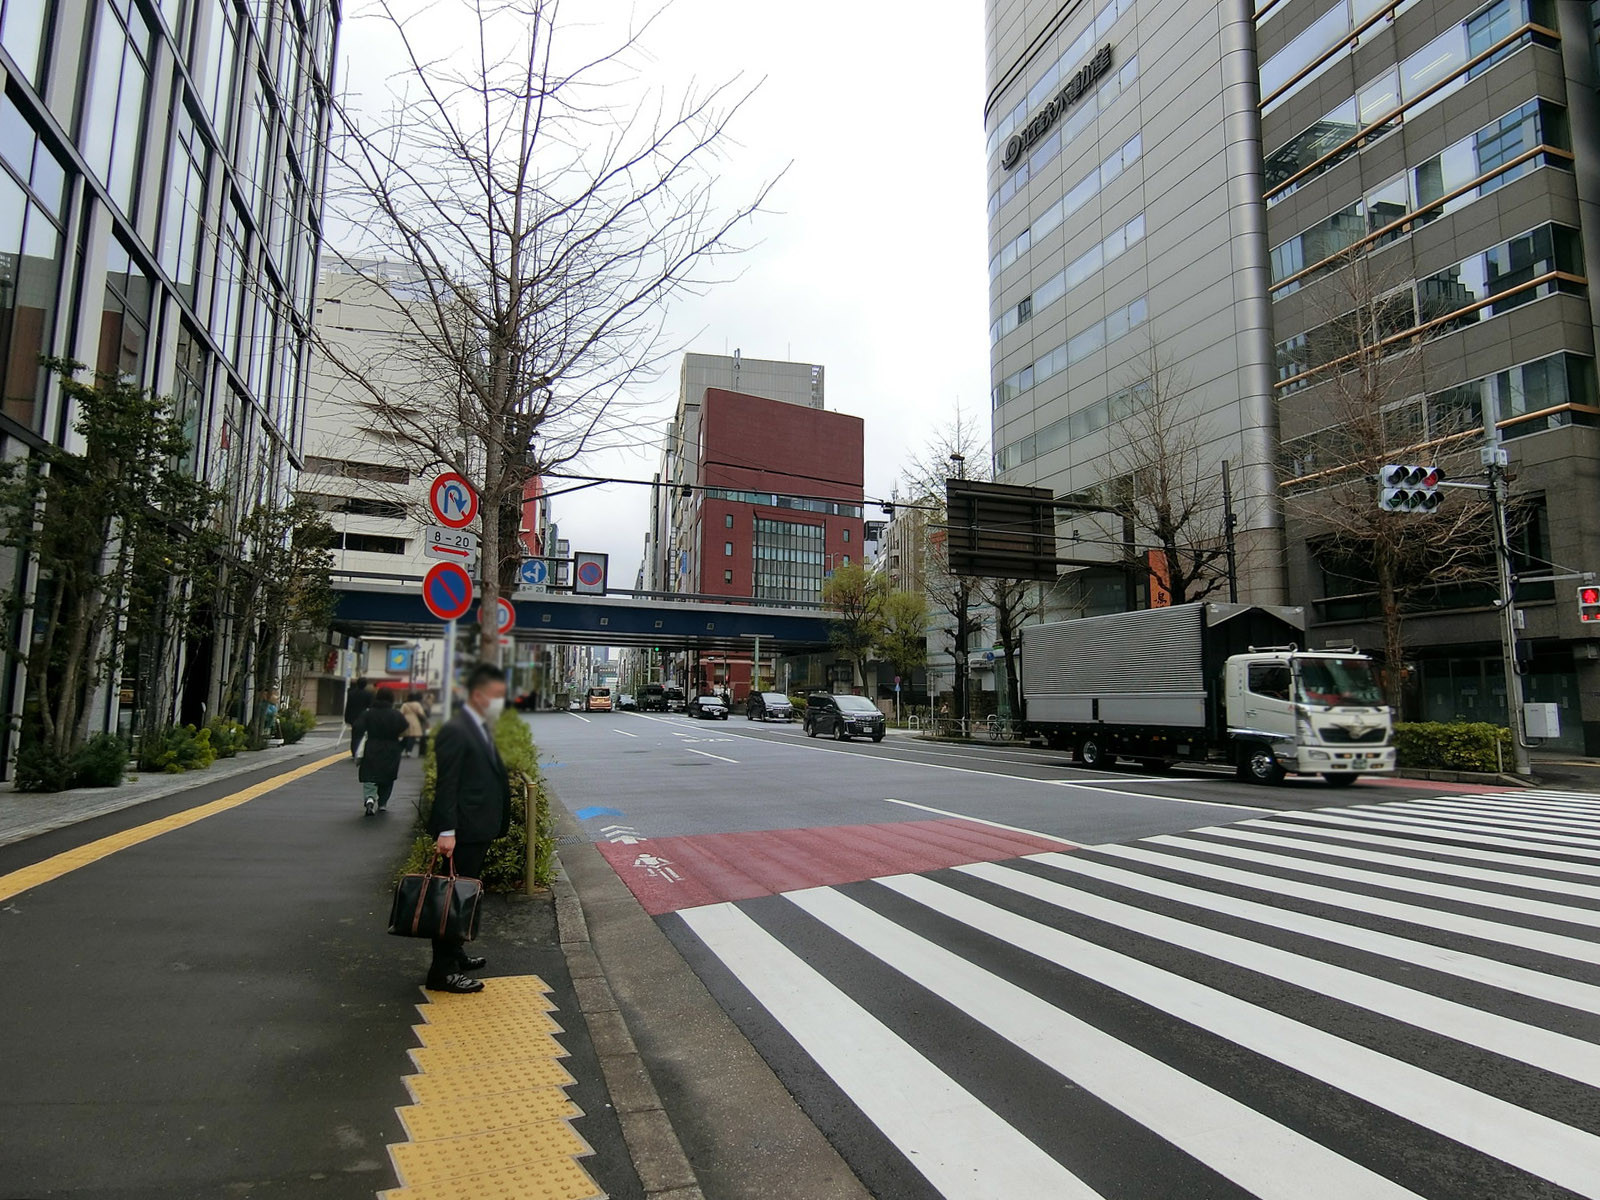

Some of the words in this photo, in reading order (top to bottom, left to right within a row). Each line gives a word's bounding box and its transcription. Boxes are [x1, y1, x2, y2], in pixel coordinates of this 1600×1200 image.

[1021, 42, 1112, 151] 近鉄不動産
